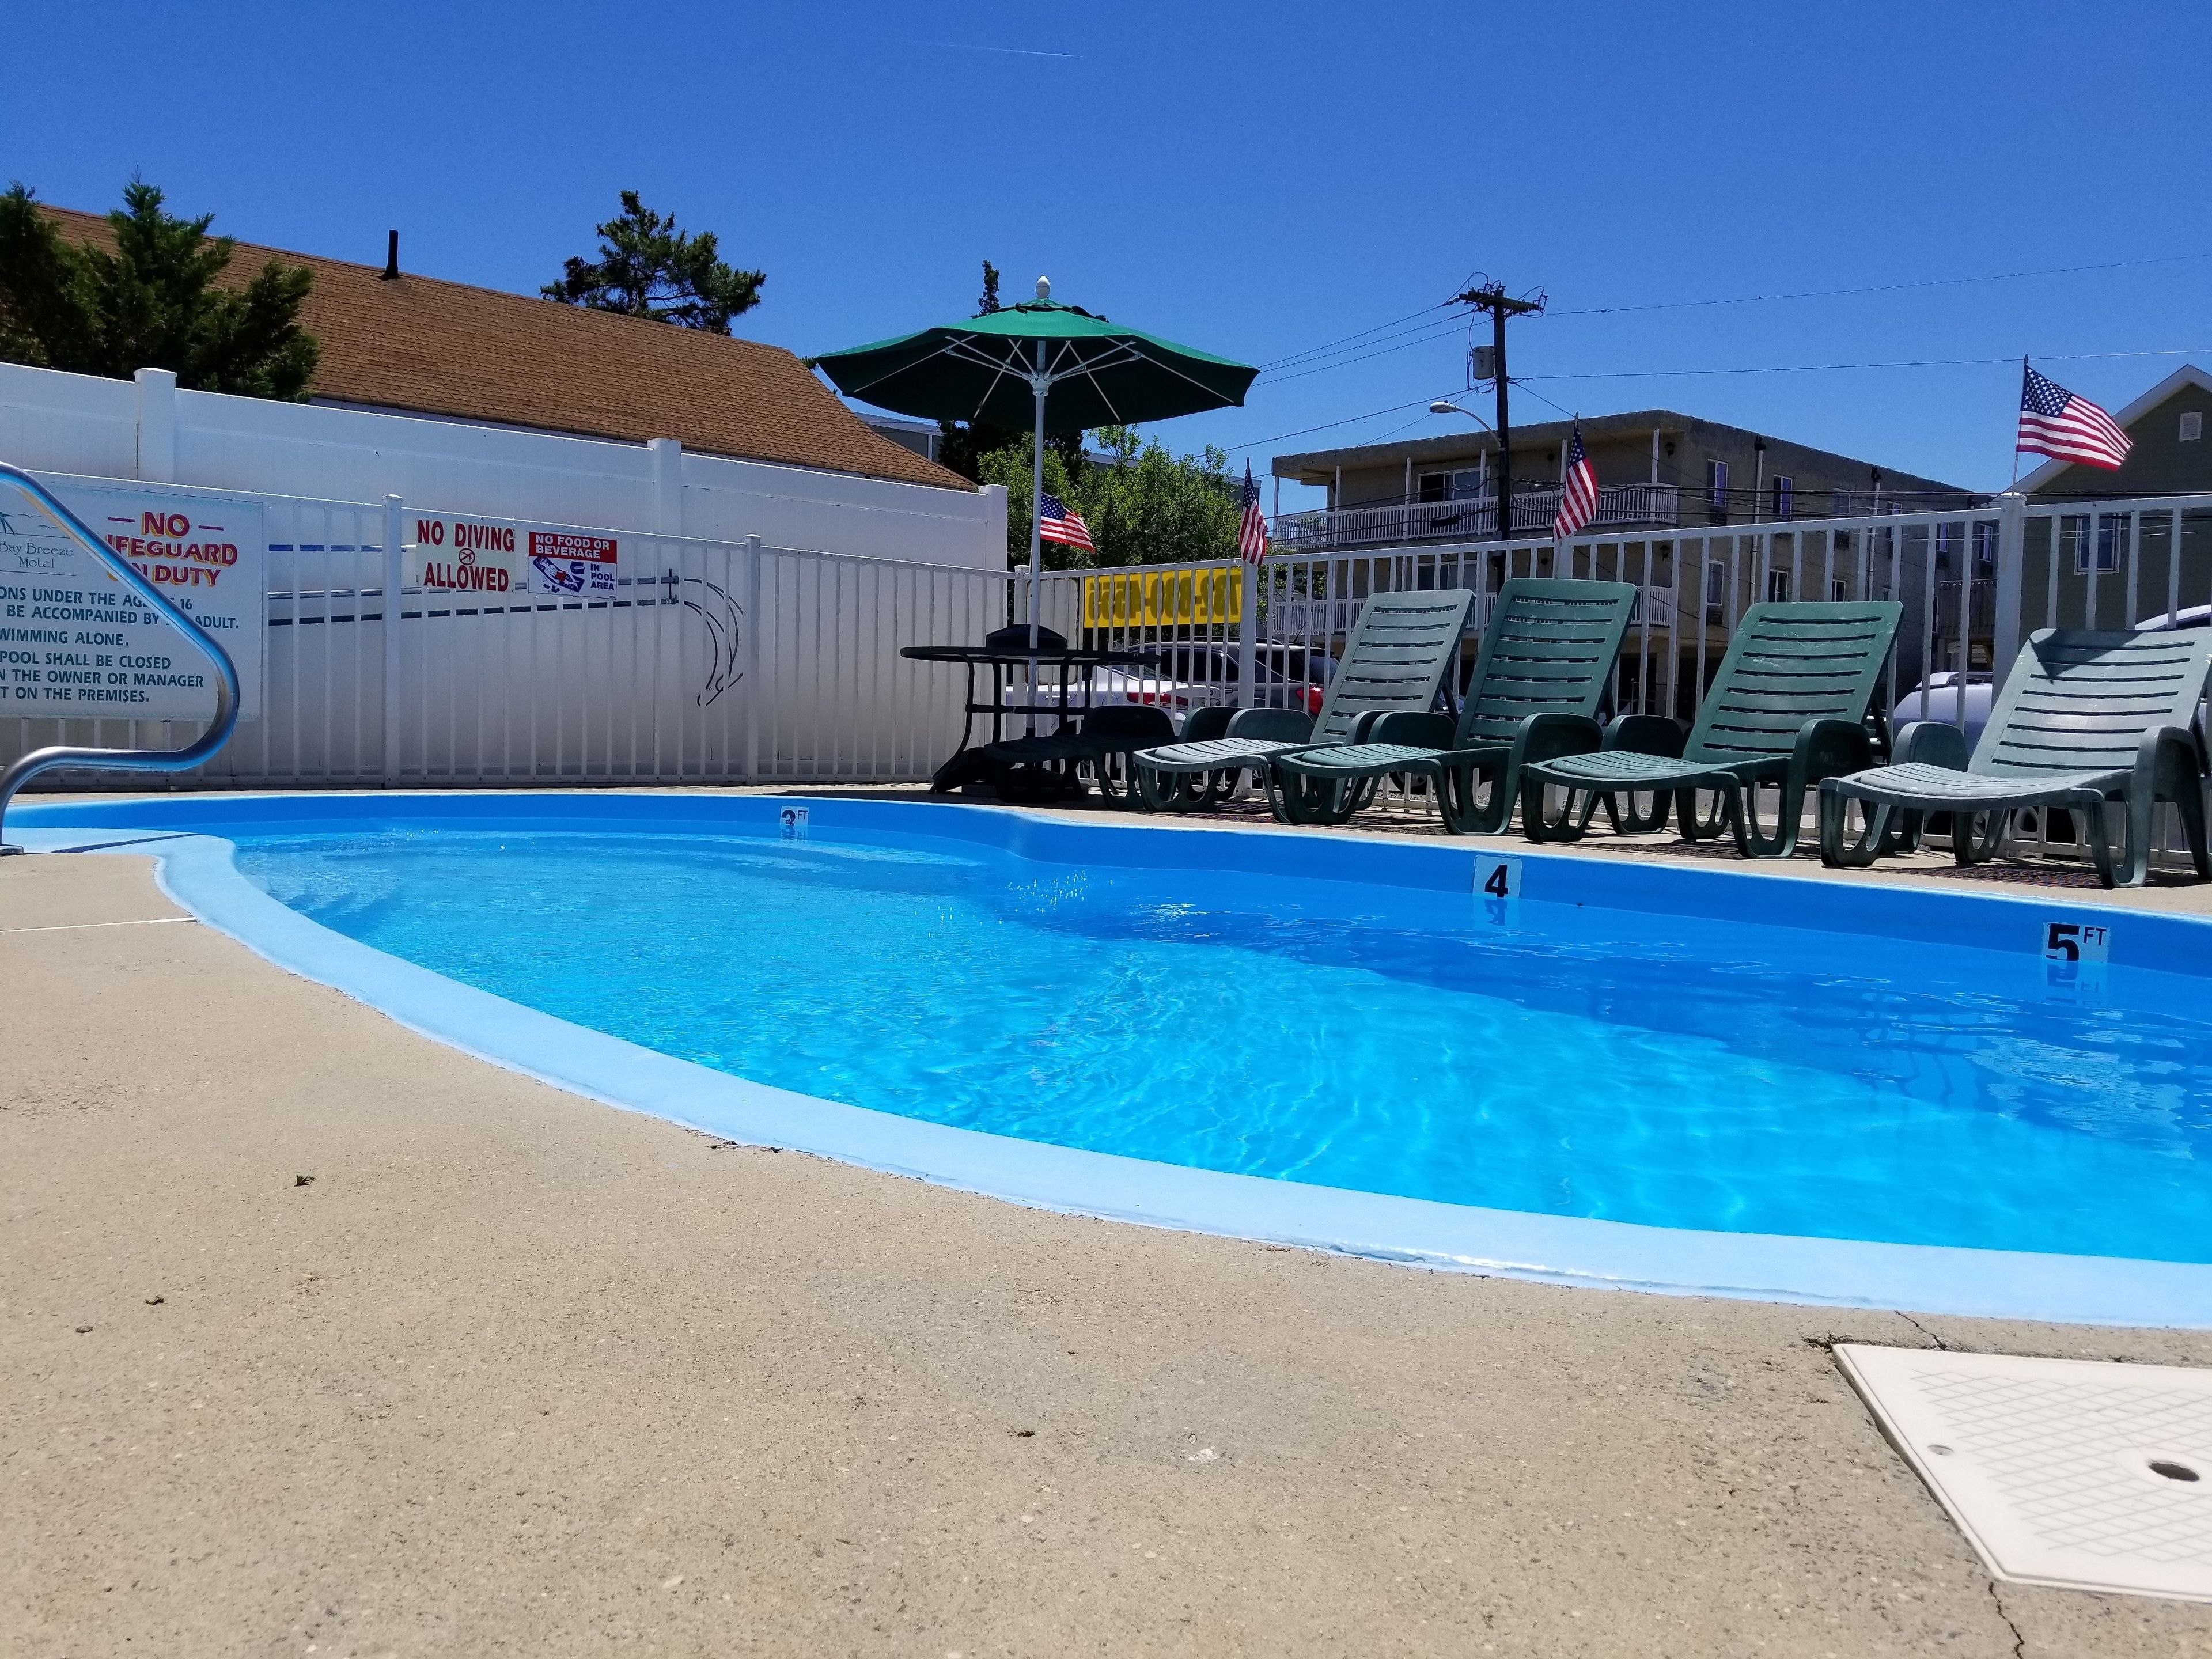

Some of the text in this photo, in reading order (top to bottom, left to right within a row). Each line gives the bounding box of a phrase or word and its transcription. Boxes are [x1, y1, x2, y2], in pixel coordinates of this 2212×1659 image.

[142, 512, 190, 537] NO
[418, 520, 514, 552] NO DIVING
[535, 534, 609, 550] NO FOOD OR
[0, 540, 73, 556] Bay Breeze
[106, 534, 238, 565] IFEGUARD
[536, 544, 600, 559] BEVERAGE
[19, 556, 54, 568] Motel
[590, 563, 600, 571] IN
[153, 565, 221, 586] DUTY
[423, 562, 509, 592] ALLOWED
[591, 573, 615, 582] POOL
[590, 581, 615, 590] AREA
[32, 588, 82, 603] UNDER
[88, 592, 115, 605] THE
[122, 594, 149, 608] AG
[180, 598, 192, 610] 16
[7, 604, 239, 629] BE ACCOMPANIED BY ADULT.
[75, 632, 128, 646] ALONE.
[0, 651, 171, 669] POOL SHALL BE CLOSED
[12, 669, 41, 682] THE
[47, 671, 101, 684] OWNER
[107, 672, 127, 684] OR
[134, 673, 203, 687] MANAGER
[15, 687, 37, 699] ON
[43, 687, 71, 700] THE
[78, 688, 149, 702] PREMISES.
[797, 810, 808, 820] FT
[1484, 864, 1509, 898] 4
[2046, 923, 2107, 961] 5 FT
